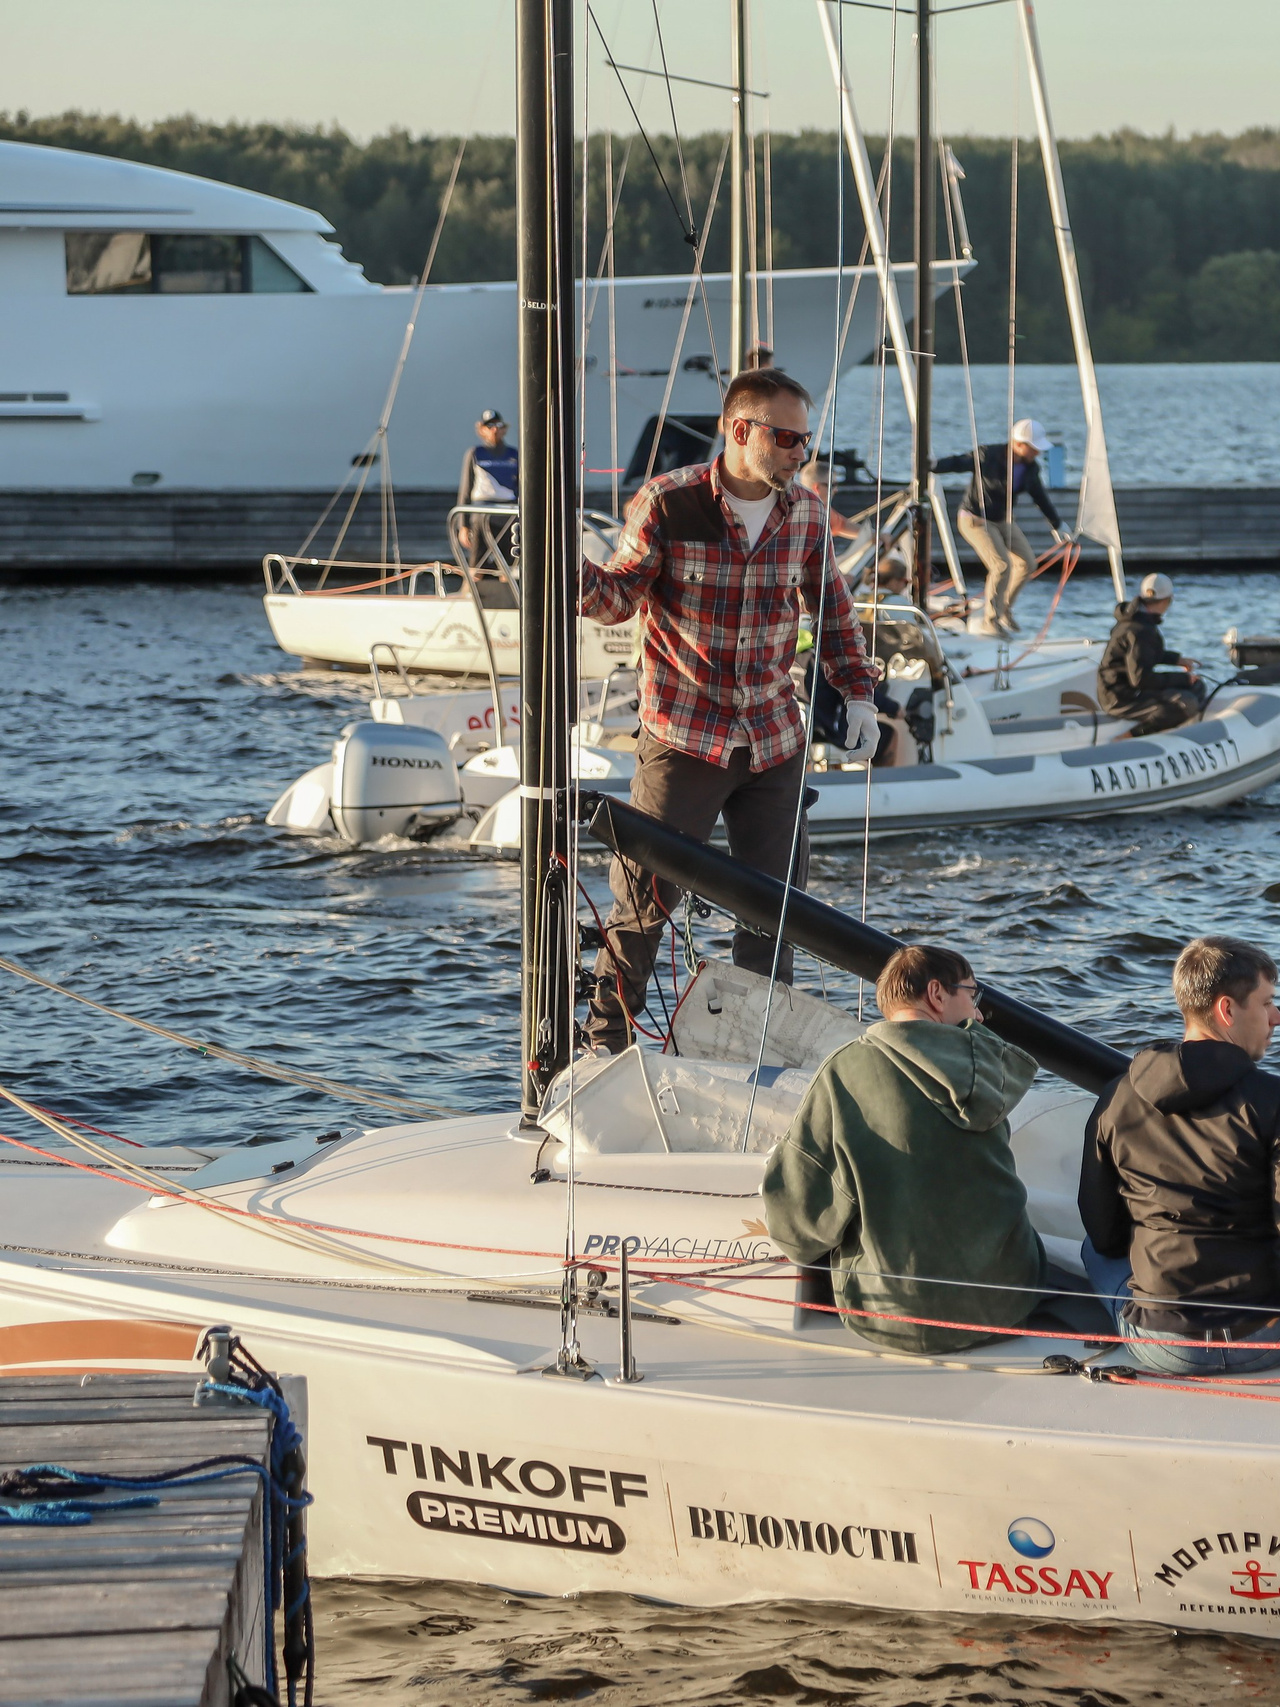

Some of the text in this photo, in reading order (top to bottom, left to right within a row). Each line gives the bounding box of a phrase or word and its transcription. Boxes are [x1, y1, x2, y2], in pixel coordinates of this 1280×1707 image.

[527, 301, 557, 310] SELDN
[372, 755, 443, 770] HONDA
[1091, 739, 1241, 793] AA0728RUS77
[366, 1435, 649, 1508] TINKOFF
[419, 1497, 613, 1549] PREMIUM
[687, 1505, 921, 1565] ВЕДОМОСТИ
[957, 1560, 1115, 1600] TASSAY
[965, 1593, 1118, 1611] PREMIUM DRINKING WATER
